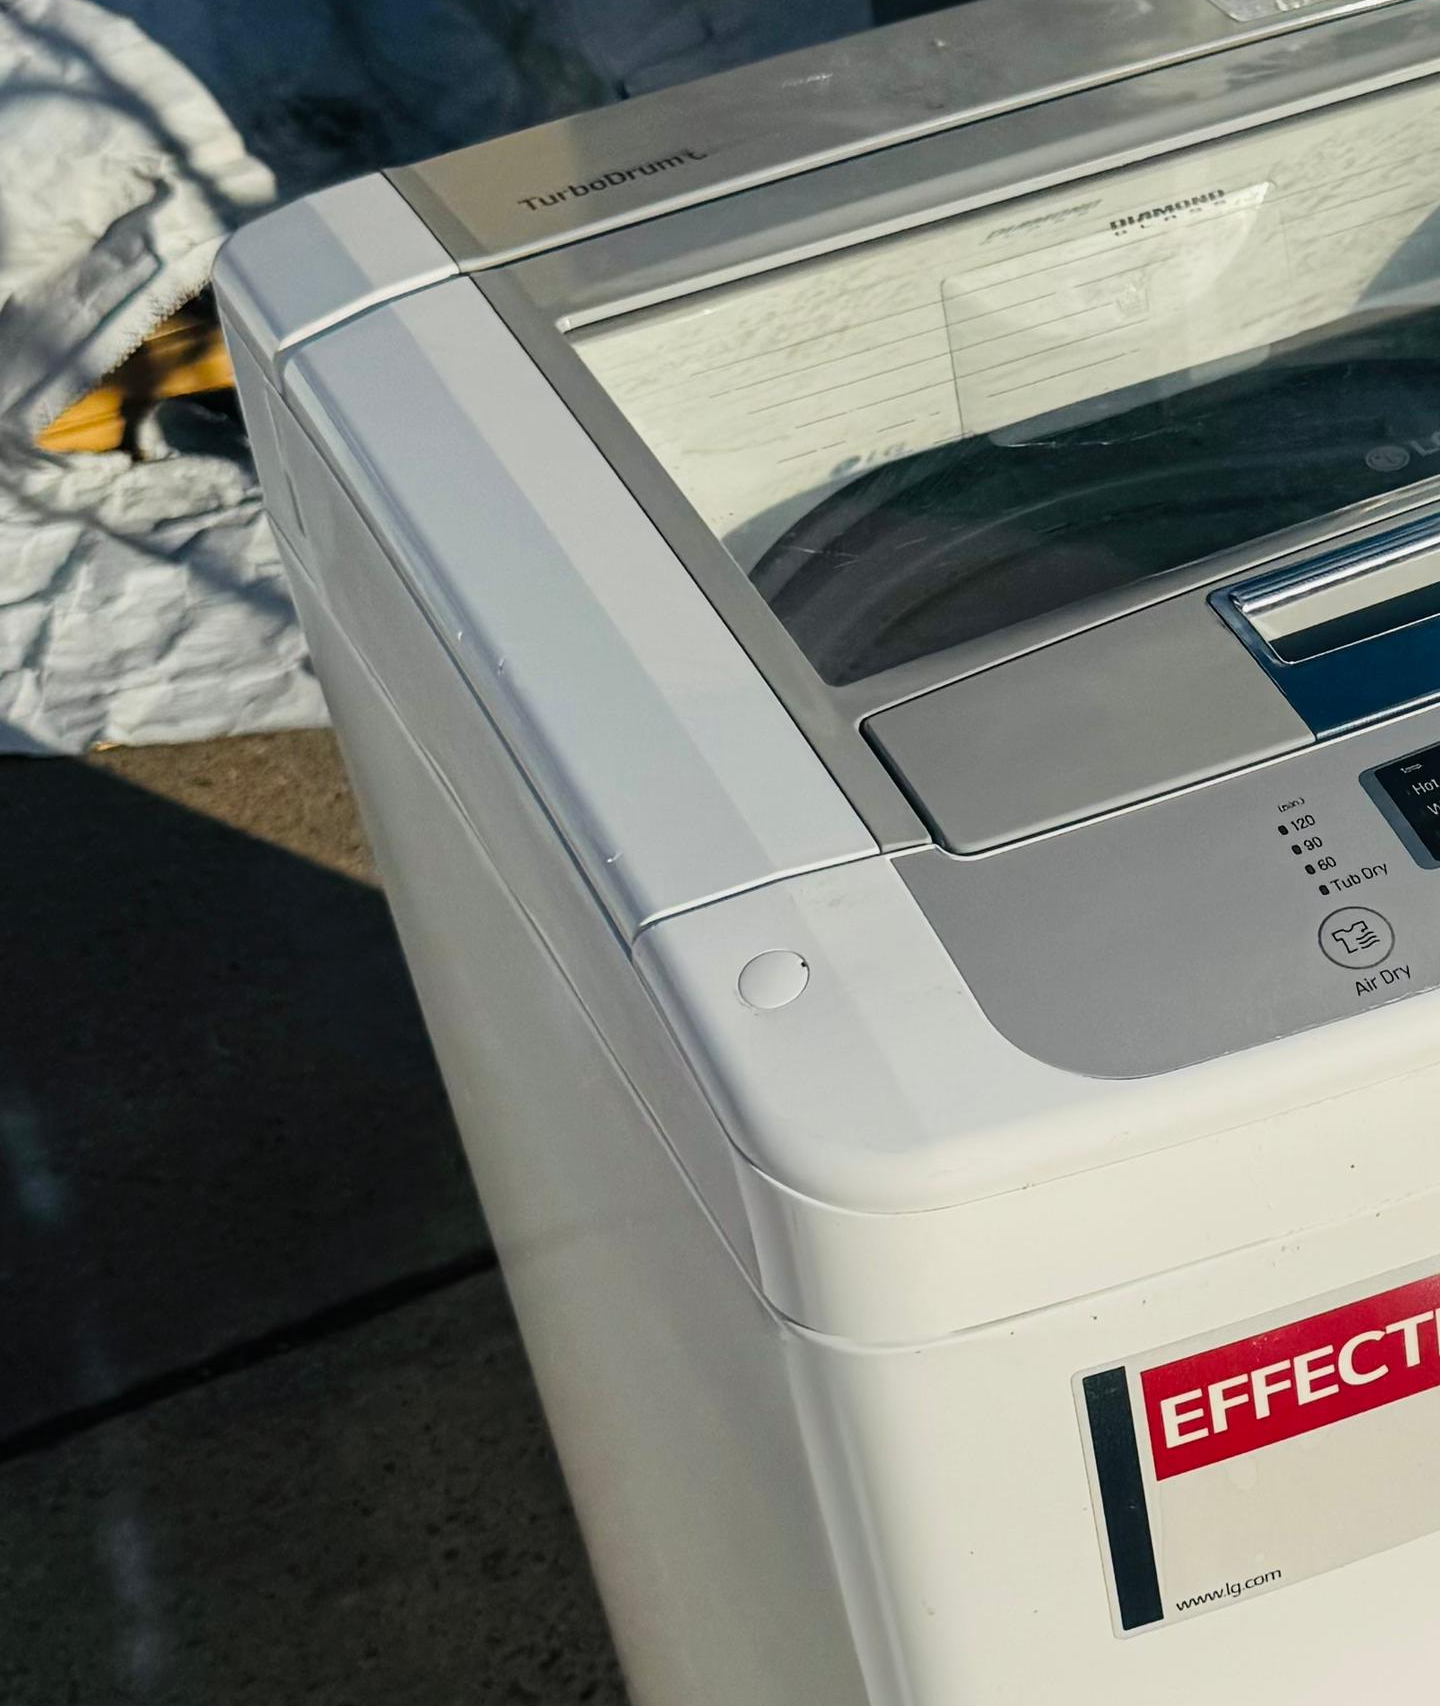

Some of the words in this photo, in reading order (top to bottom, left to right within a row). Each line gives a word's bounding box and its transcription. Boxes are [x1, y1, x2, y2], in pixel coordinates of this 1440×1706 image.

[517, 154, 686, 211] TurboDrum
[1109, 189, 1226, 231] DIAMOND
[1412, 778, 1440, 796] Hot
[1290, 814, 1316, 832] 120
[1303, 836, 1323, 851] 90
[1317, 856, 1337, 871] 60
[1329, 874, 1361, 892] Tub
[1360, 863, 1388, 880] Dry
[1354, 976, 1378, 997] Air
[1379, 964, 1412, 986] Dry
[1176, 1568, 1282, 1612] www.lg.com
